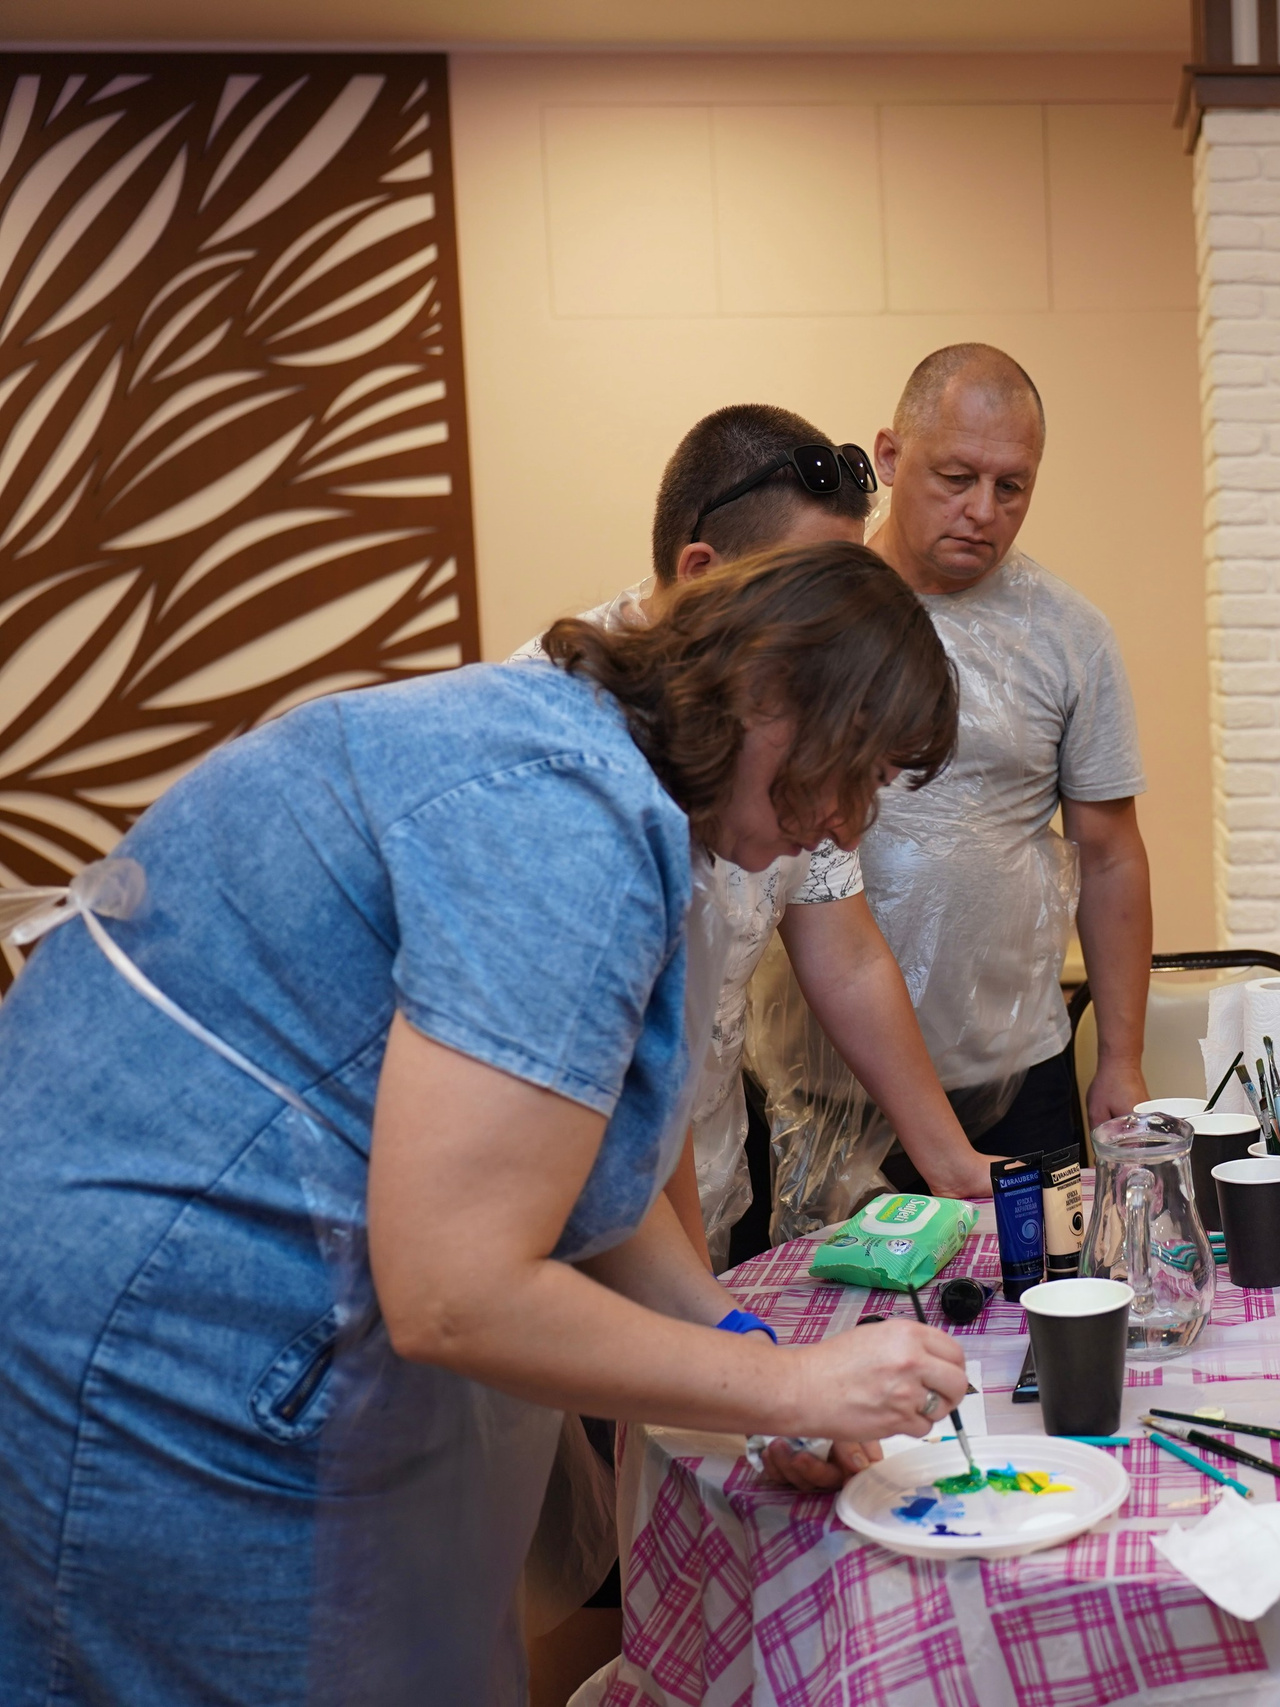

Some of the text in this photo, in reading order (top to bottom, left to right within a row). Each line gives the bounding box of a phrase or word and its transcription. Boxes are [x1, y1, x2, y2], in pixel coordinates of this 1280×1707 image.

[1057, 1166, 1080, 1179] BRAUBERG
[1007, 1173, 1039, 1186] BRAUBERG
[893, 1198, 927, 1222] Salfeti
